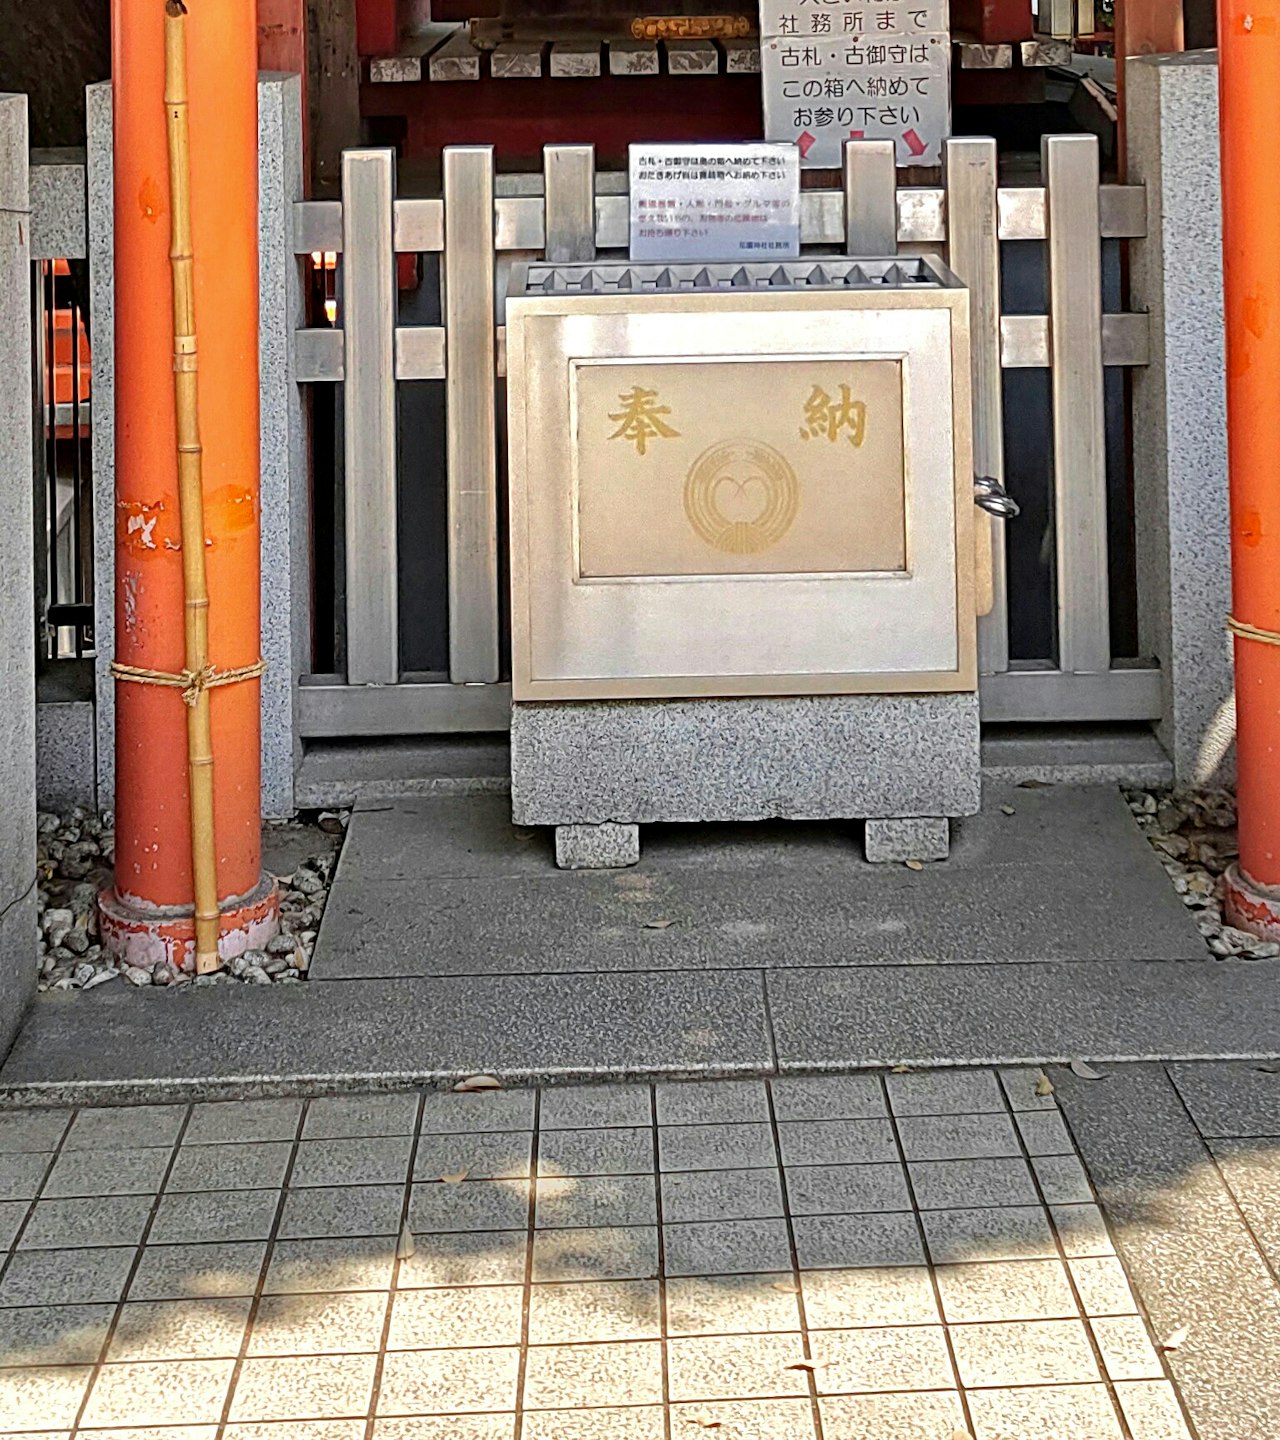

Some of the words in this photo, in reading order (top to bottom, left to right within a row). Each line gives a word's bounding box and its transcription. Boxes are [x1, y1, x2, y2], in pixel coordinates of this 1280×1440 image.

[779, 10, 928, 34] 社務所まで
[781, 44, 930, 67] 古札・古御守は
[783, 76, 930, 99] この箱へ納めて
[793, 106, 920, 128] お参り下さい
